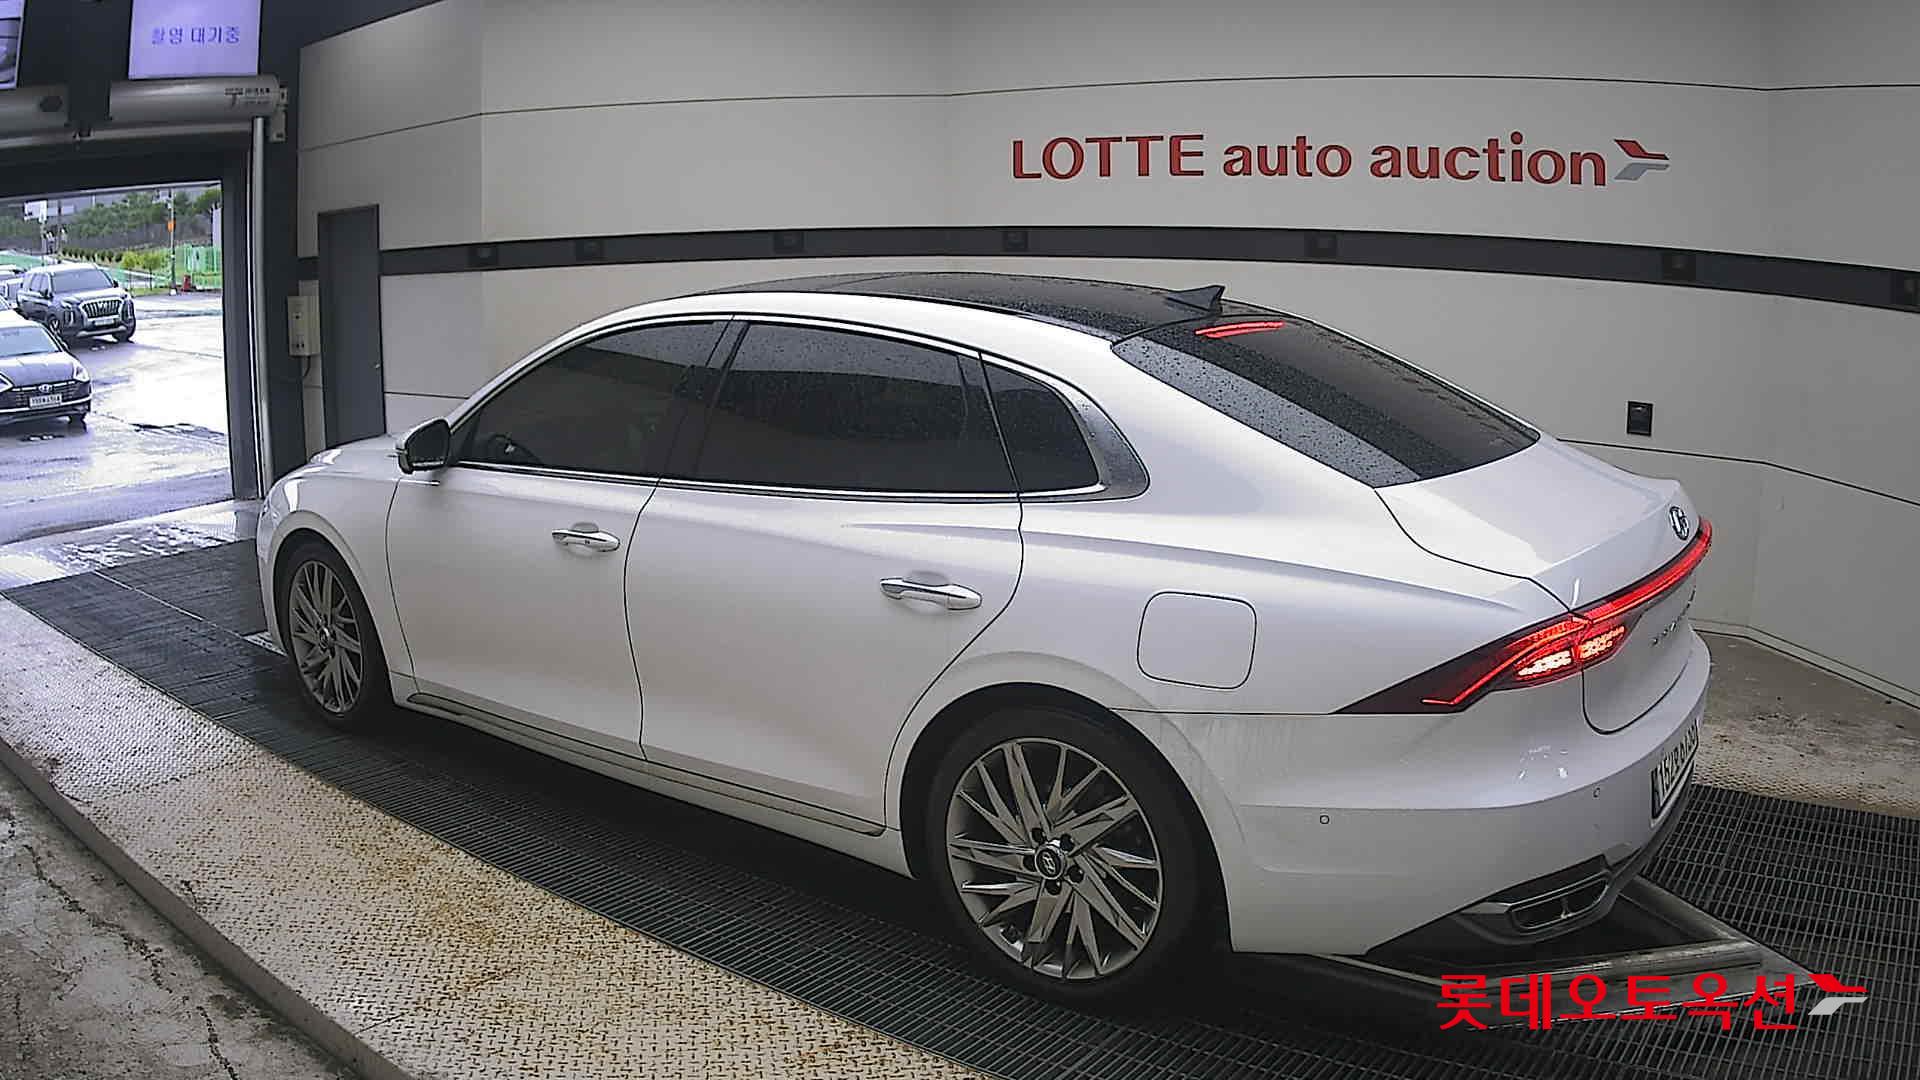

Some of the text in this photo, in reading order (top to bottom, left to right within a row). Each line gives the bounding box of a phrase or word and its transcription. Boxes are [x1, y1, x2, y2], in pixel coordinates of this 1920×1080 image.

[191, 26, 240, 45] 대기중
[1012, 131, 1606, 186] LOTTE auto auction
